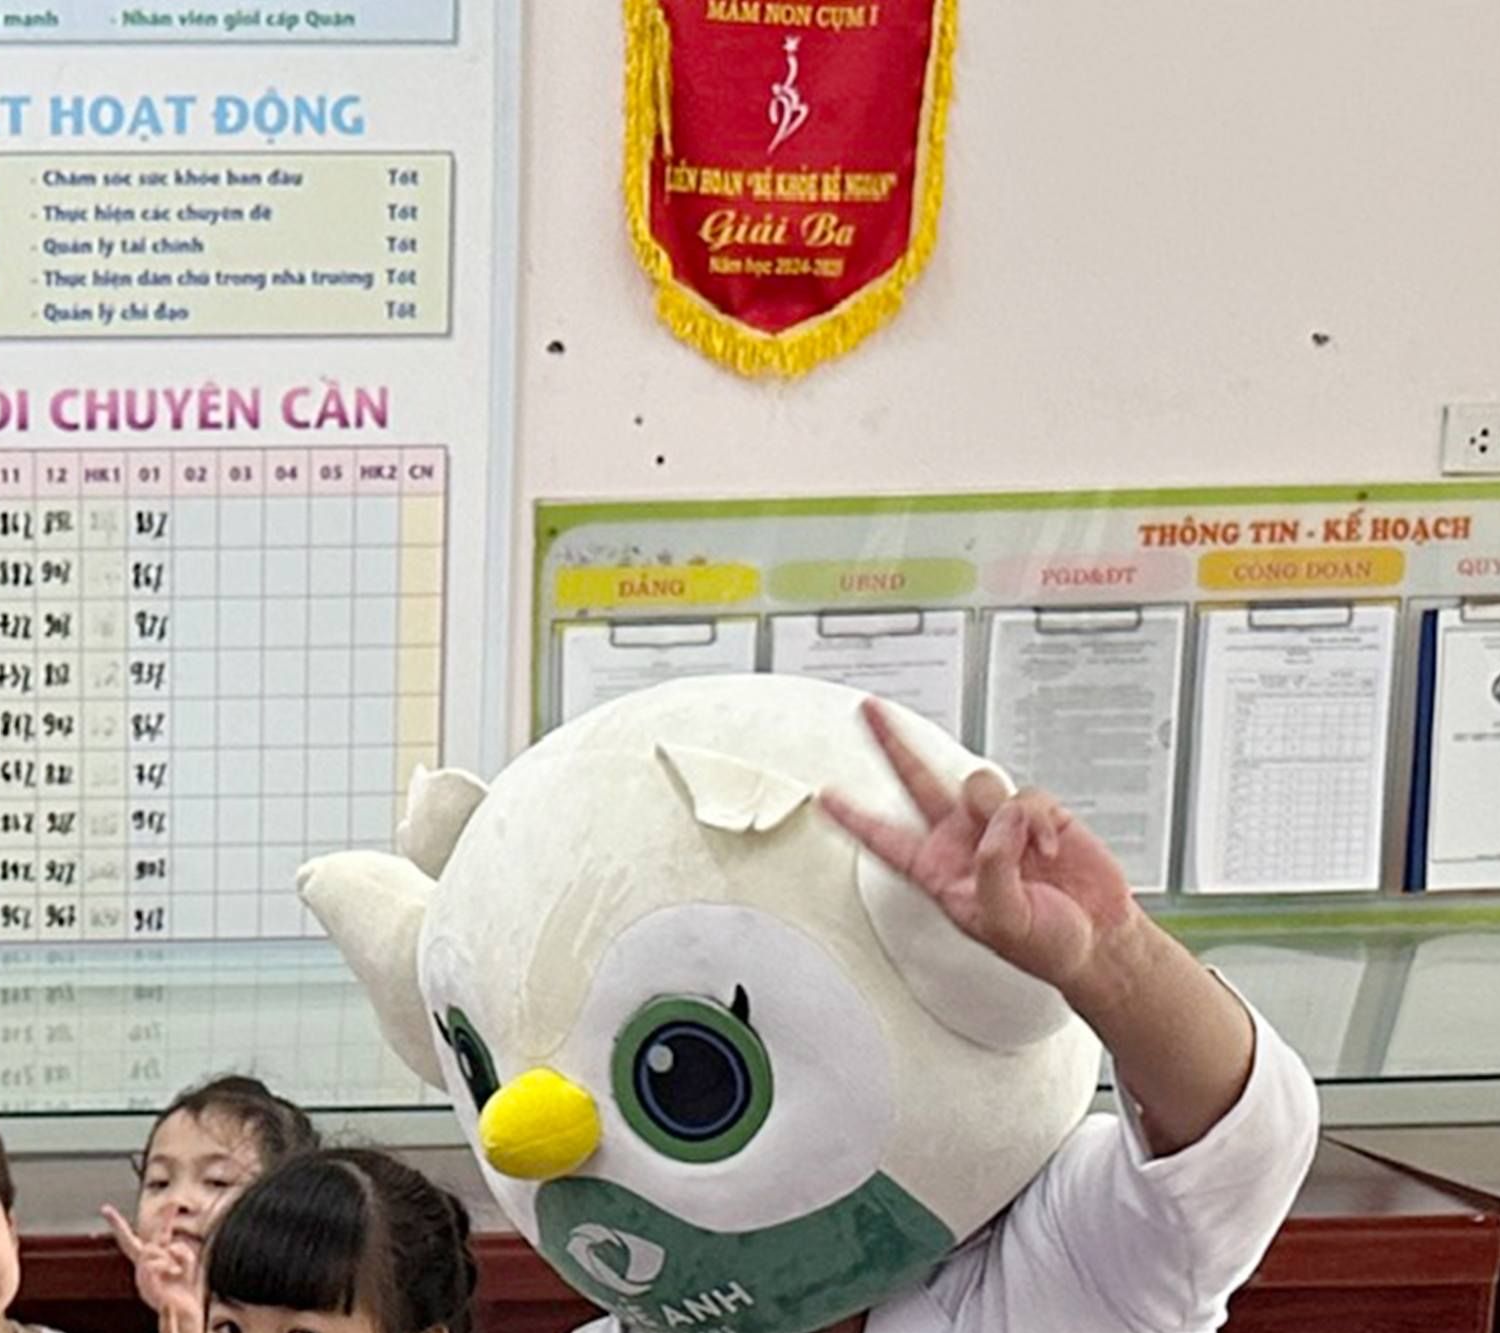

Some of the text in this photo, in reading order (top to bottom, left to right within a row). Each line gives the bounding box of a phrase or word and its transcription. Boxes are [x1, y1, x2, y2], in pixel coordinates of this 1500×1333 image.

[763, 3, 811, 26] NON
[49, 94, 197, 143] HOẠT
[211, 87, 365, 144] ĐỘNG
[699, 210, 854, 250] Giải Ba
[49, 380, 261, 431] CHUYÊN
[280, 373, 389, 429] CẦN
[1, 468, 20, 483] 11
[46, 468, 67, 483] 12
[138, 467, 160, 482] 01
[184, 467, 207, 482] 02
[230, 467, 251, 481] 03
[320, 466, 343, 480] 05
[408, 465, 434, 479] CN
[1139, 509, 1472, 546] THÔNG TIN KẾ HOẠCH
[661, 1282, 754, 1328] ANH
